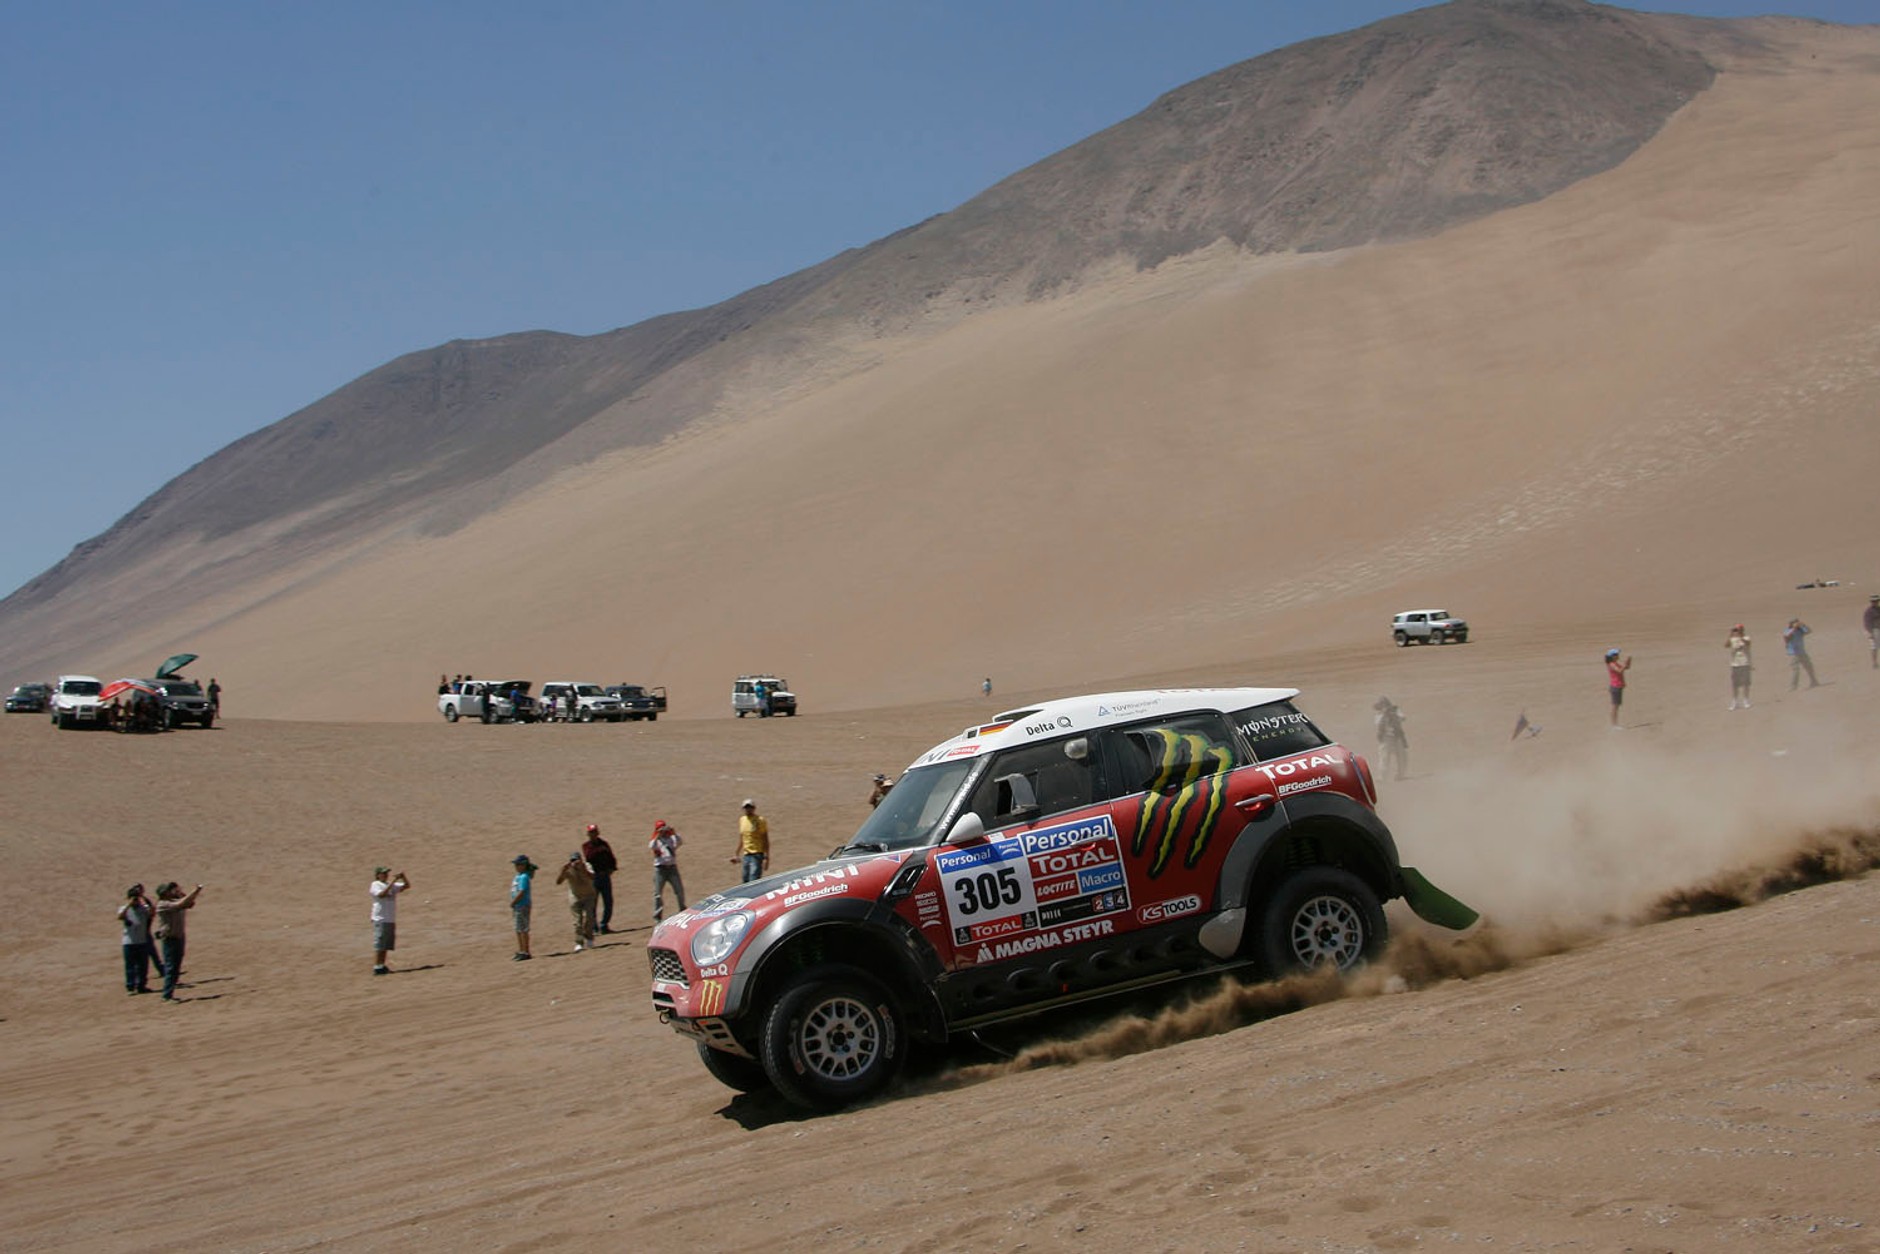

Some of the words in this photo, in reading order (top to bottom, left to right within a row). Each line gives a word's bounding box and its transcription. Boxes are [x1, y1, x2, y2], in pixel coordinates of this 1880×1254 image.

[1026, 721, 1055, 736] Delta
[1255, 753, 1342, 780] TOTAL
[1279, 775, 1331, 794] BFGoodrich
[1026, 818, 1109, 853] Personal
[941, 851, 991, 869] Personal
[1033, 847, 1114, 874] TOTAL
[1037, 880, 1076, 896] LOCTITE
[1082, 871, 1121, 888] Macro
[784, 883, 848, 905] BFGoodrich
[955, 867, 1022, 915] 305
[1143, 906, 1162, 920] KS
[1163, 898, 1197, 915] TOOLS
[973, 920, 1022, 938] TOTAL
[996, 933, 1061, 958] MAGNA
[1063, 920, 1114, 943] STEYR
